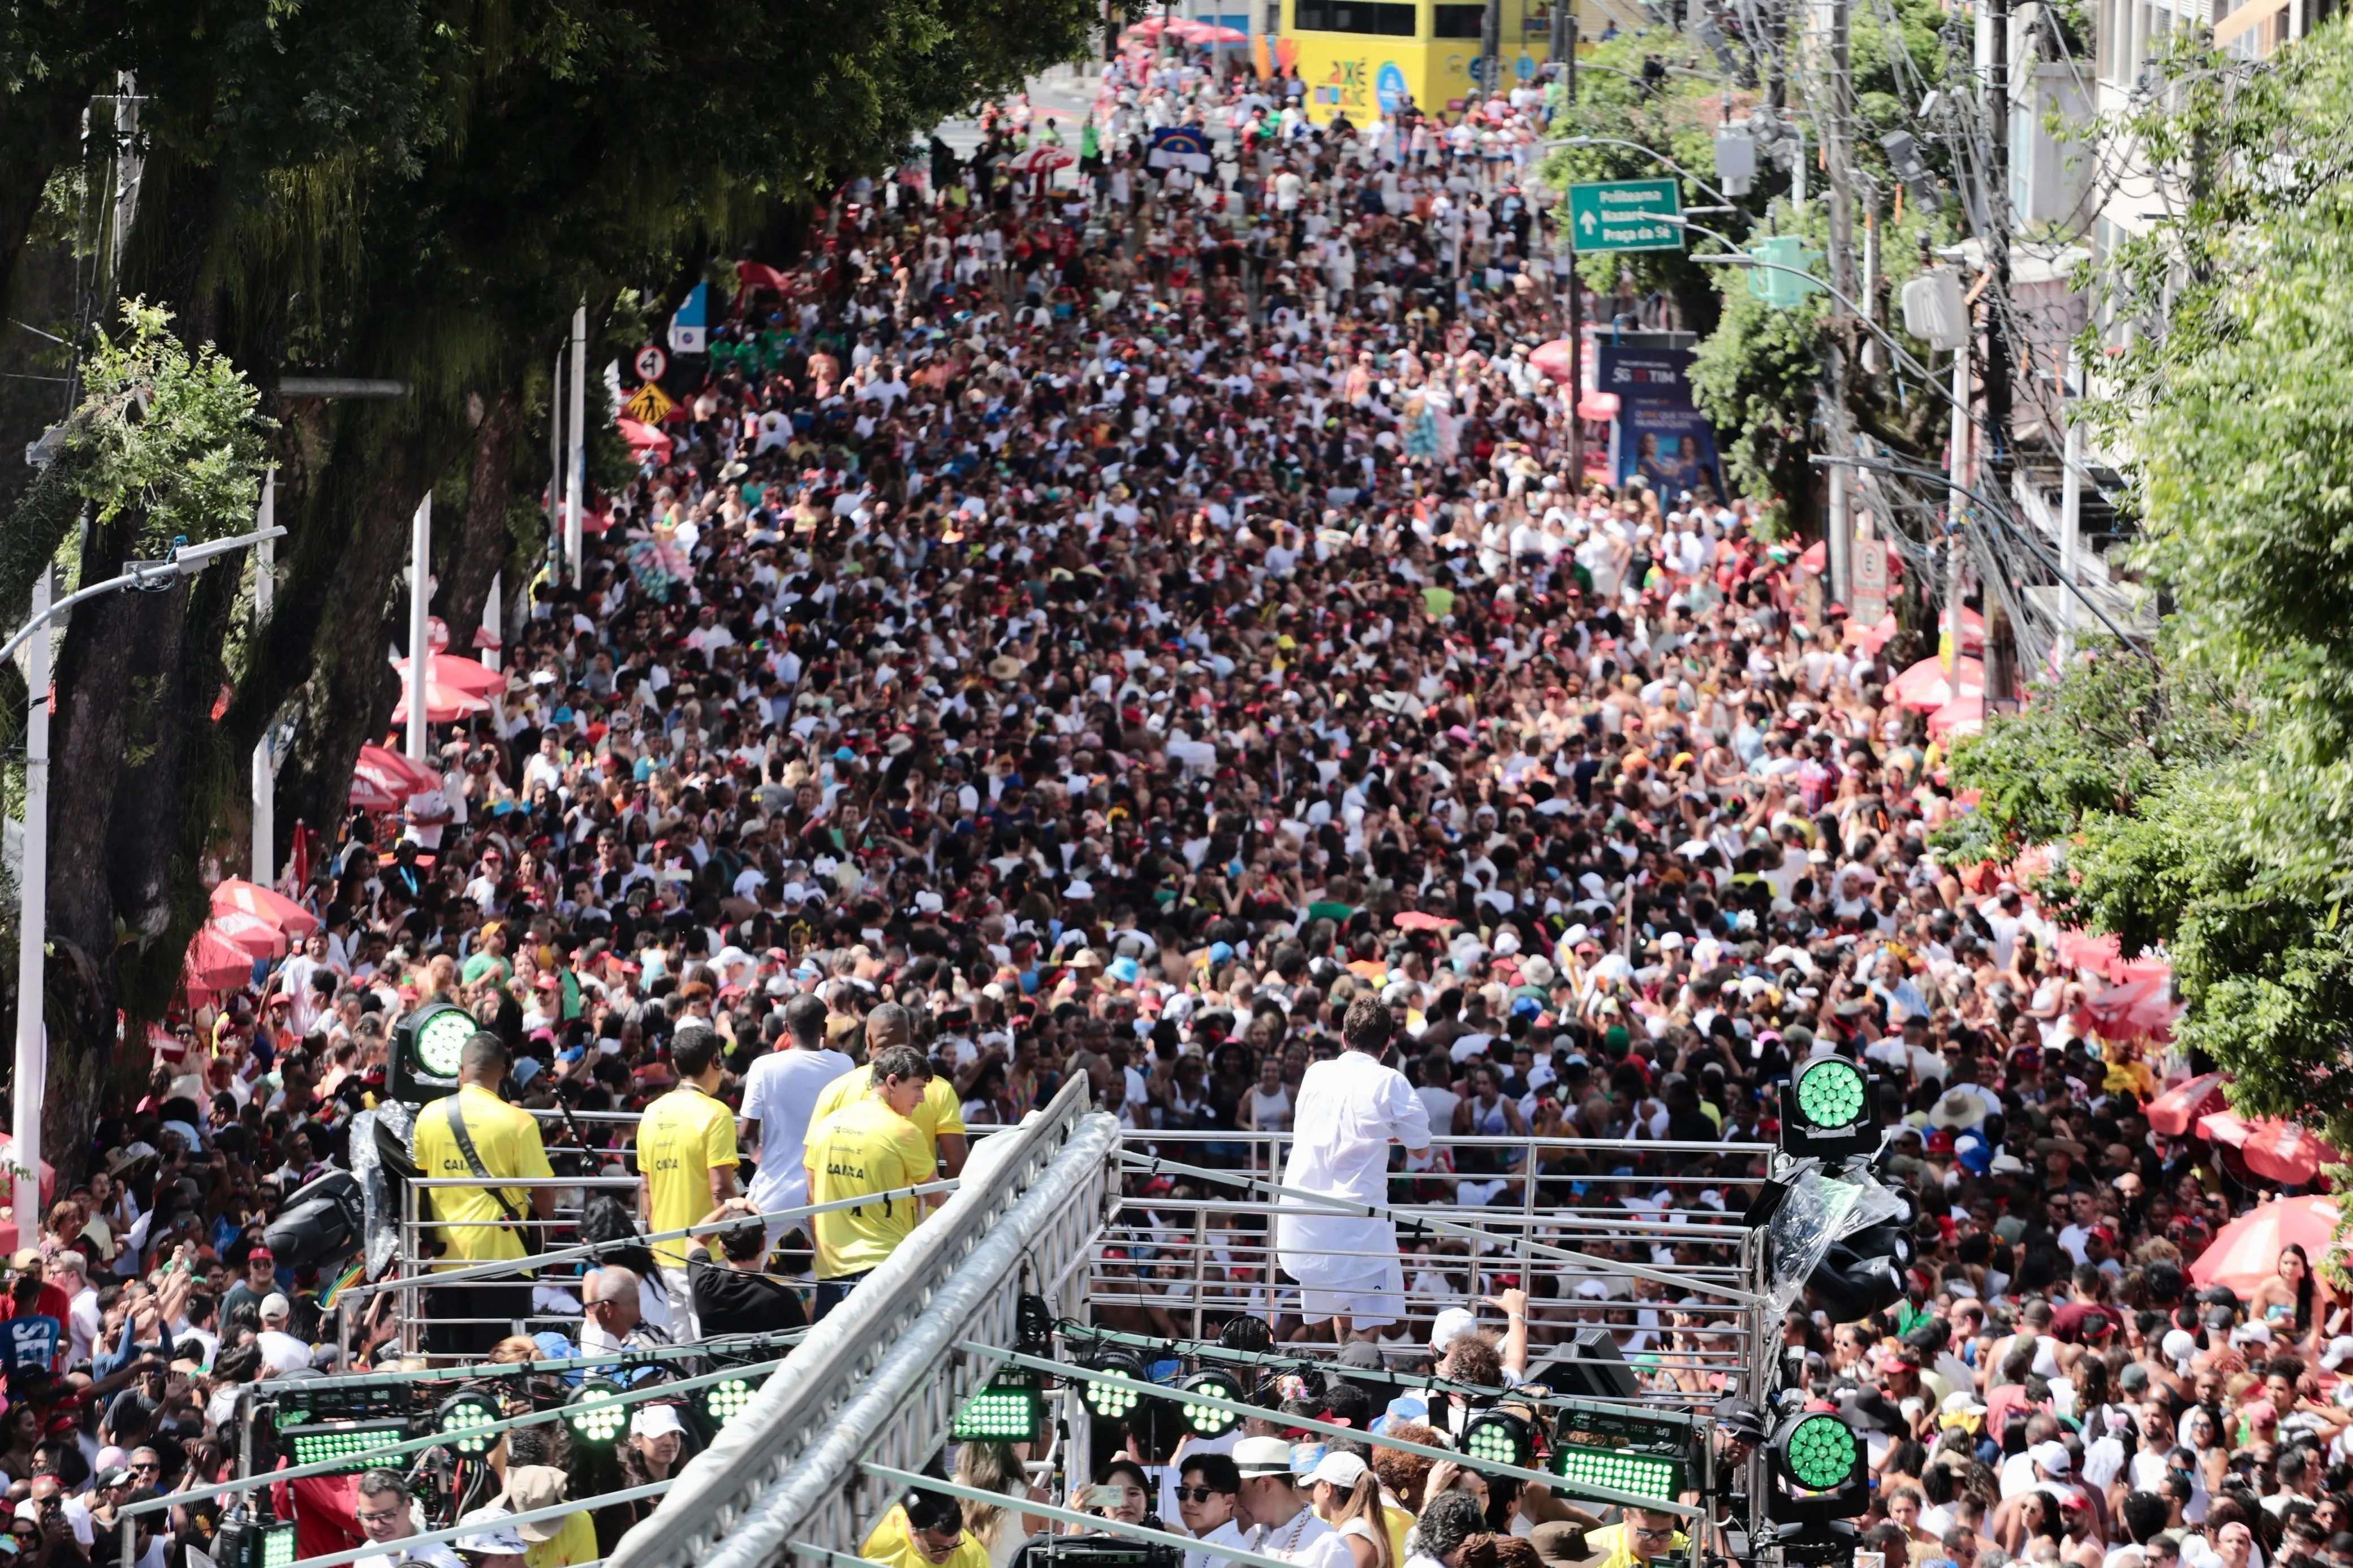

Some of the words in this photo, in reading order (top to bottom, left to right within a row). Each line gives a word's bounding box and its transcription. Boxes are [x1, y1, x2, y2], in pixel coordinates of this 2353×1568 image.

[1602, 228, 1637, 244] Praça
[1637, 226, 1654, 240] da
[1654, 224, 1672, 239] Sé
[1648, 369, 1676, 385] TIM
[827, 1163, 864, 1180] CAIXA
